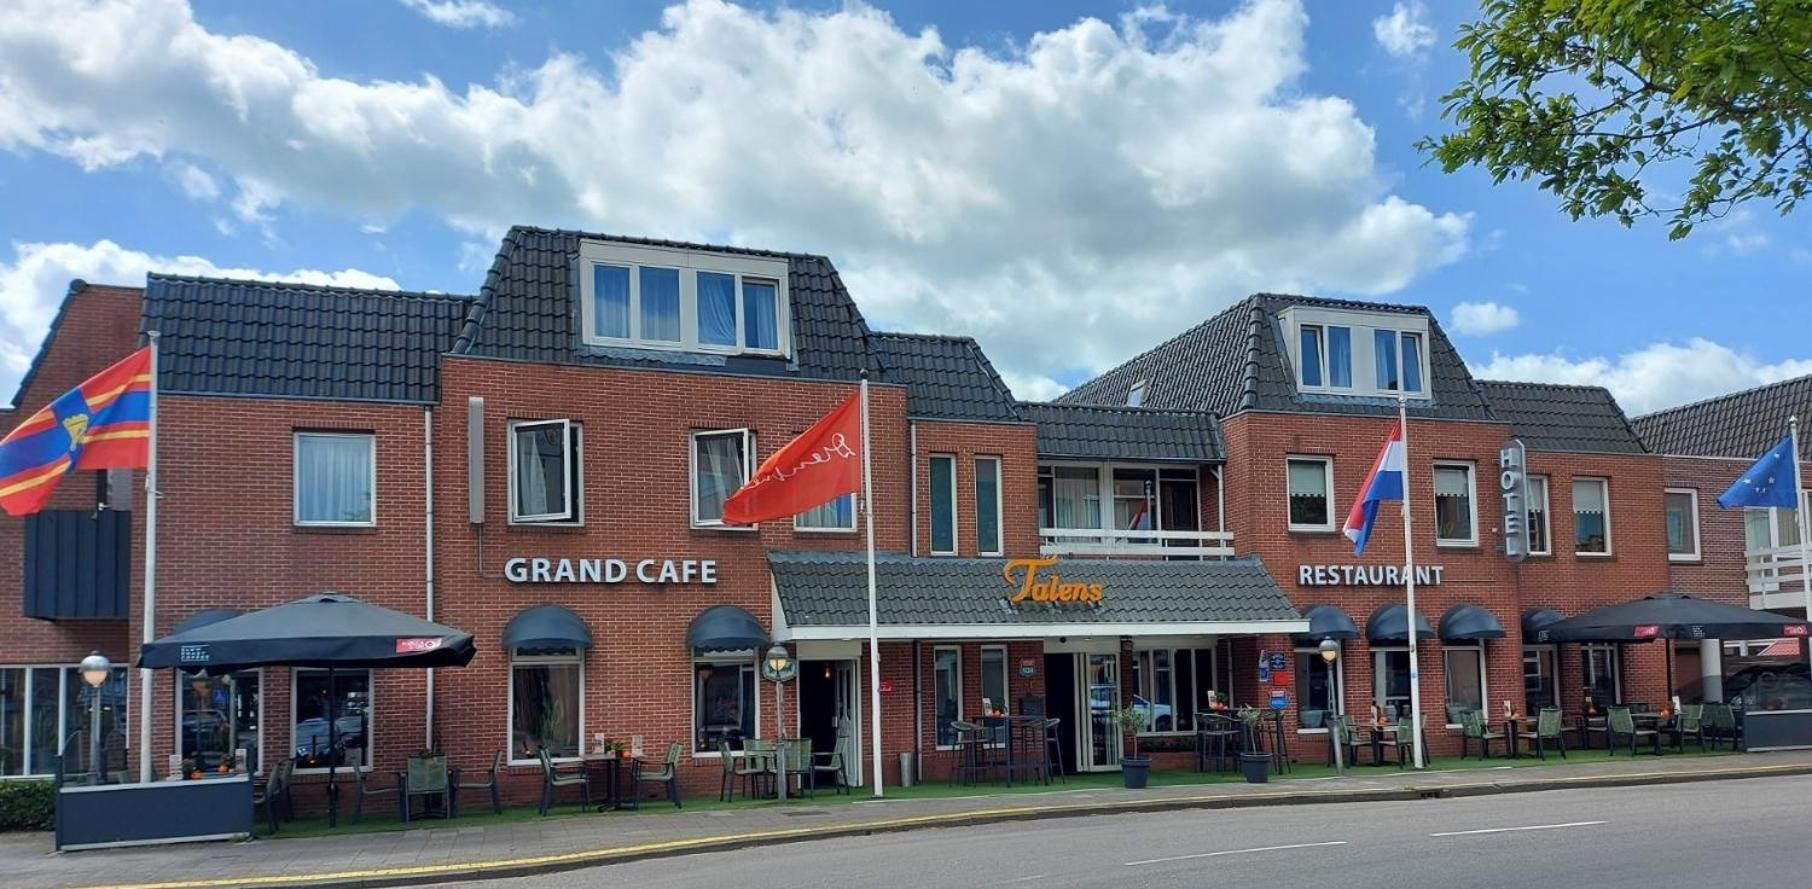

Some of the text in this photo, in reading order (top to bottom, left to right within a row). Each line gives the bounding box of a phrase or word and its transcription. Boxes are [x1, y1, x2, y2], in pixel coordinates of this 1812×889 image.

[1500, 448, 1519, 556] HOTEL
[504, 557, 717, 583] GRAND CAFE
[1003, 554, 1103, 602] Talens
[1299, 565, 1444, 585] RESTAURANT
